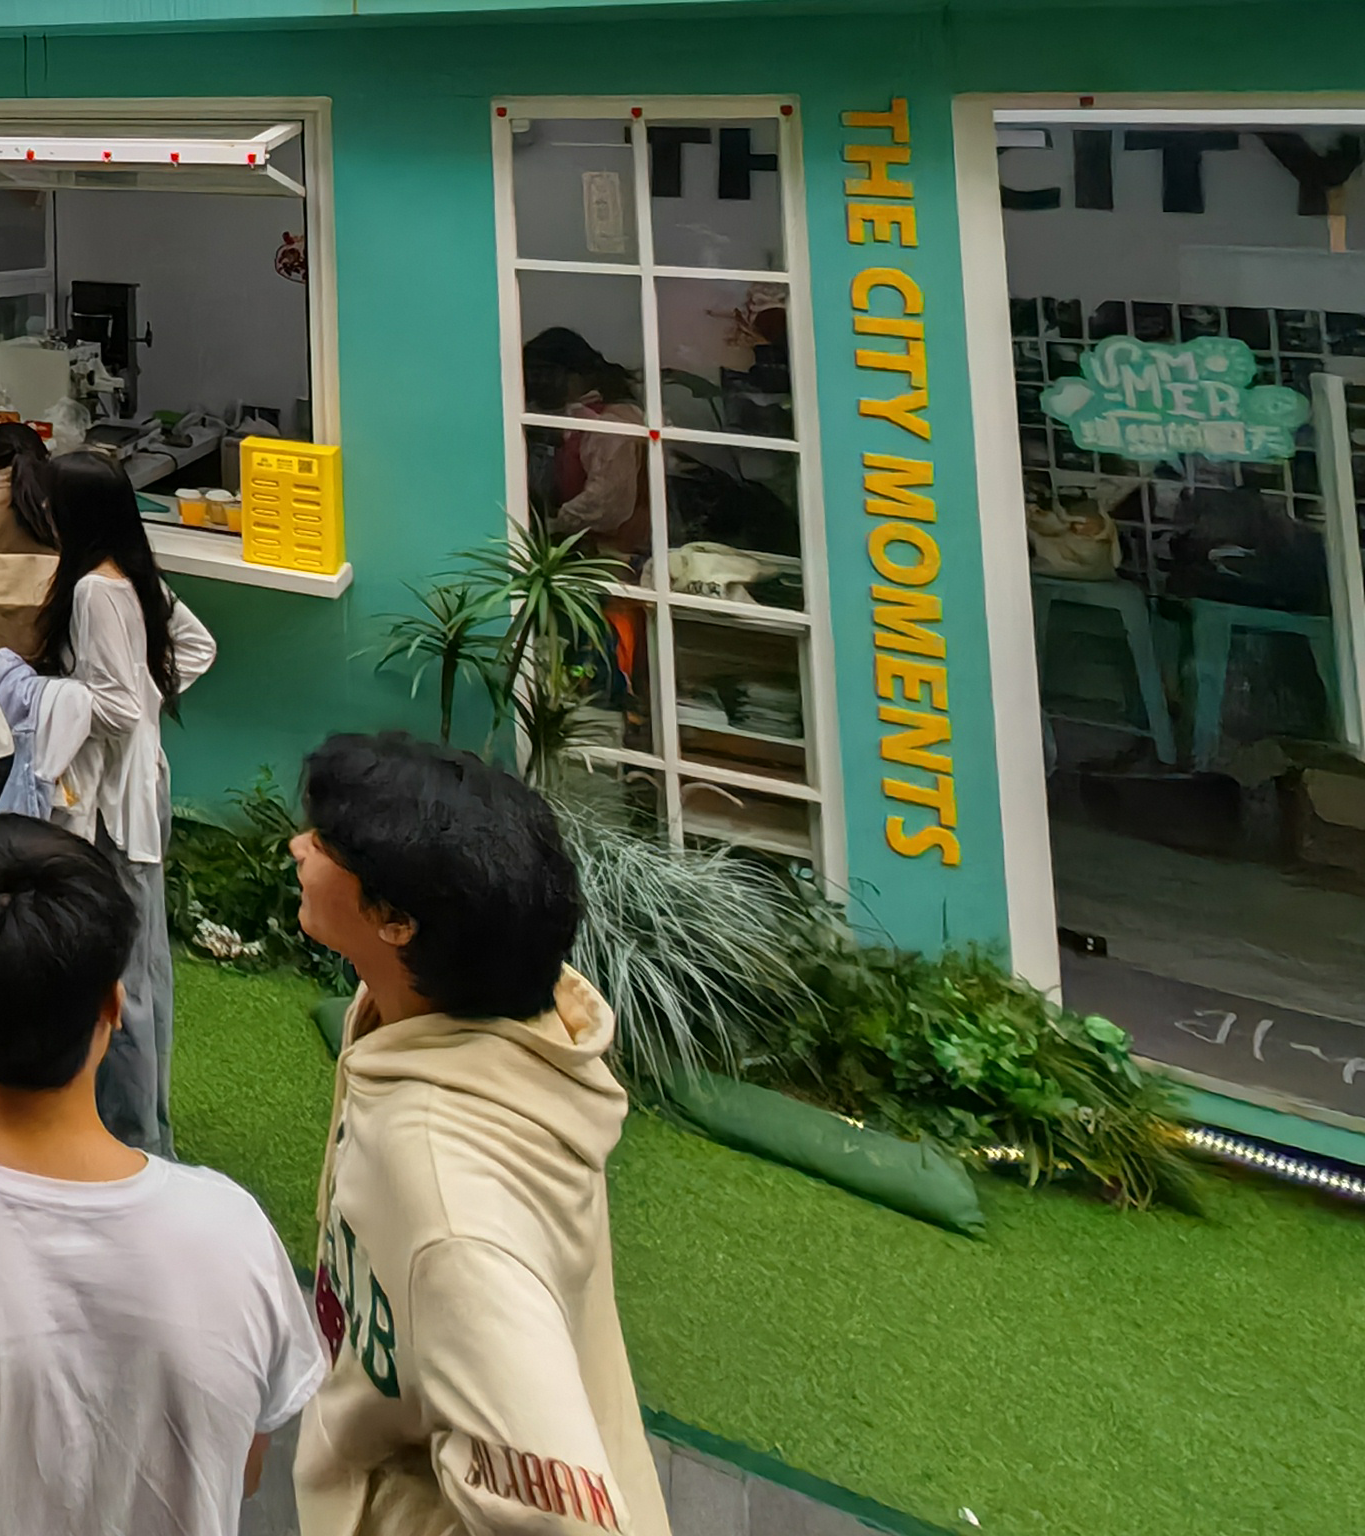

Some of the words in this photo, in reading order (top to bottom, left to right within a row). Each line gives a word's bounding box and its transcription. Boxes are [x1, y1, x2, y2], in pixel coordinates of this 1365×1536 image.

[839, 96, 919, 248] THE
[850, 266, 932, 443] CITY
[861, 453, 962, 867] MOMENTS
